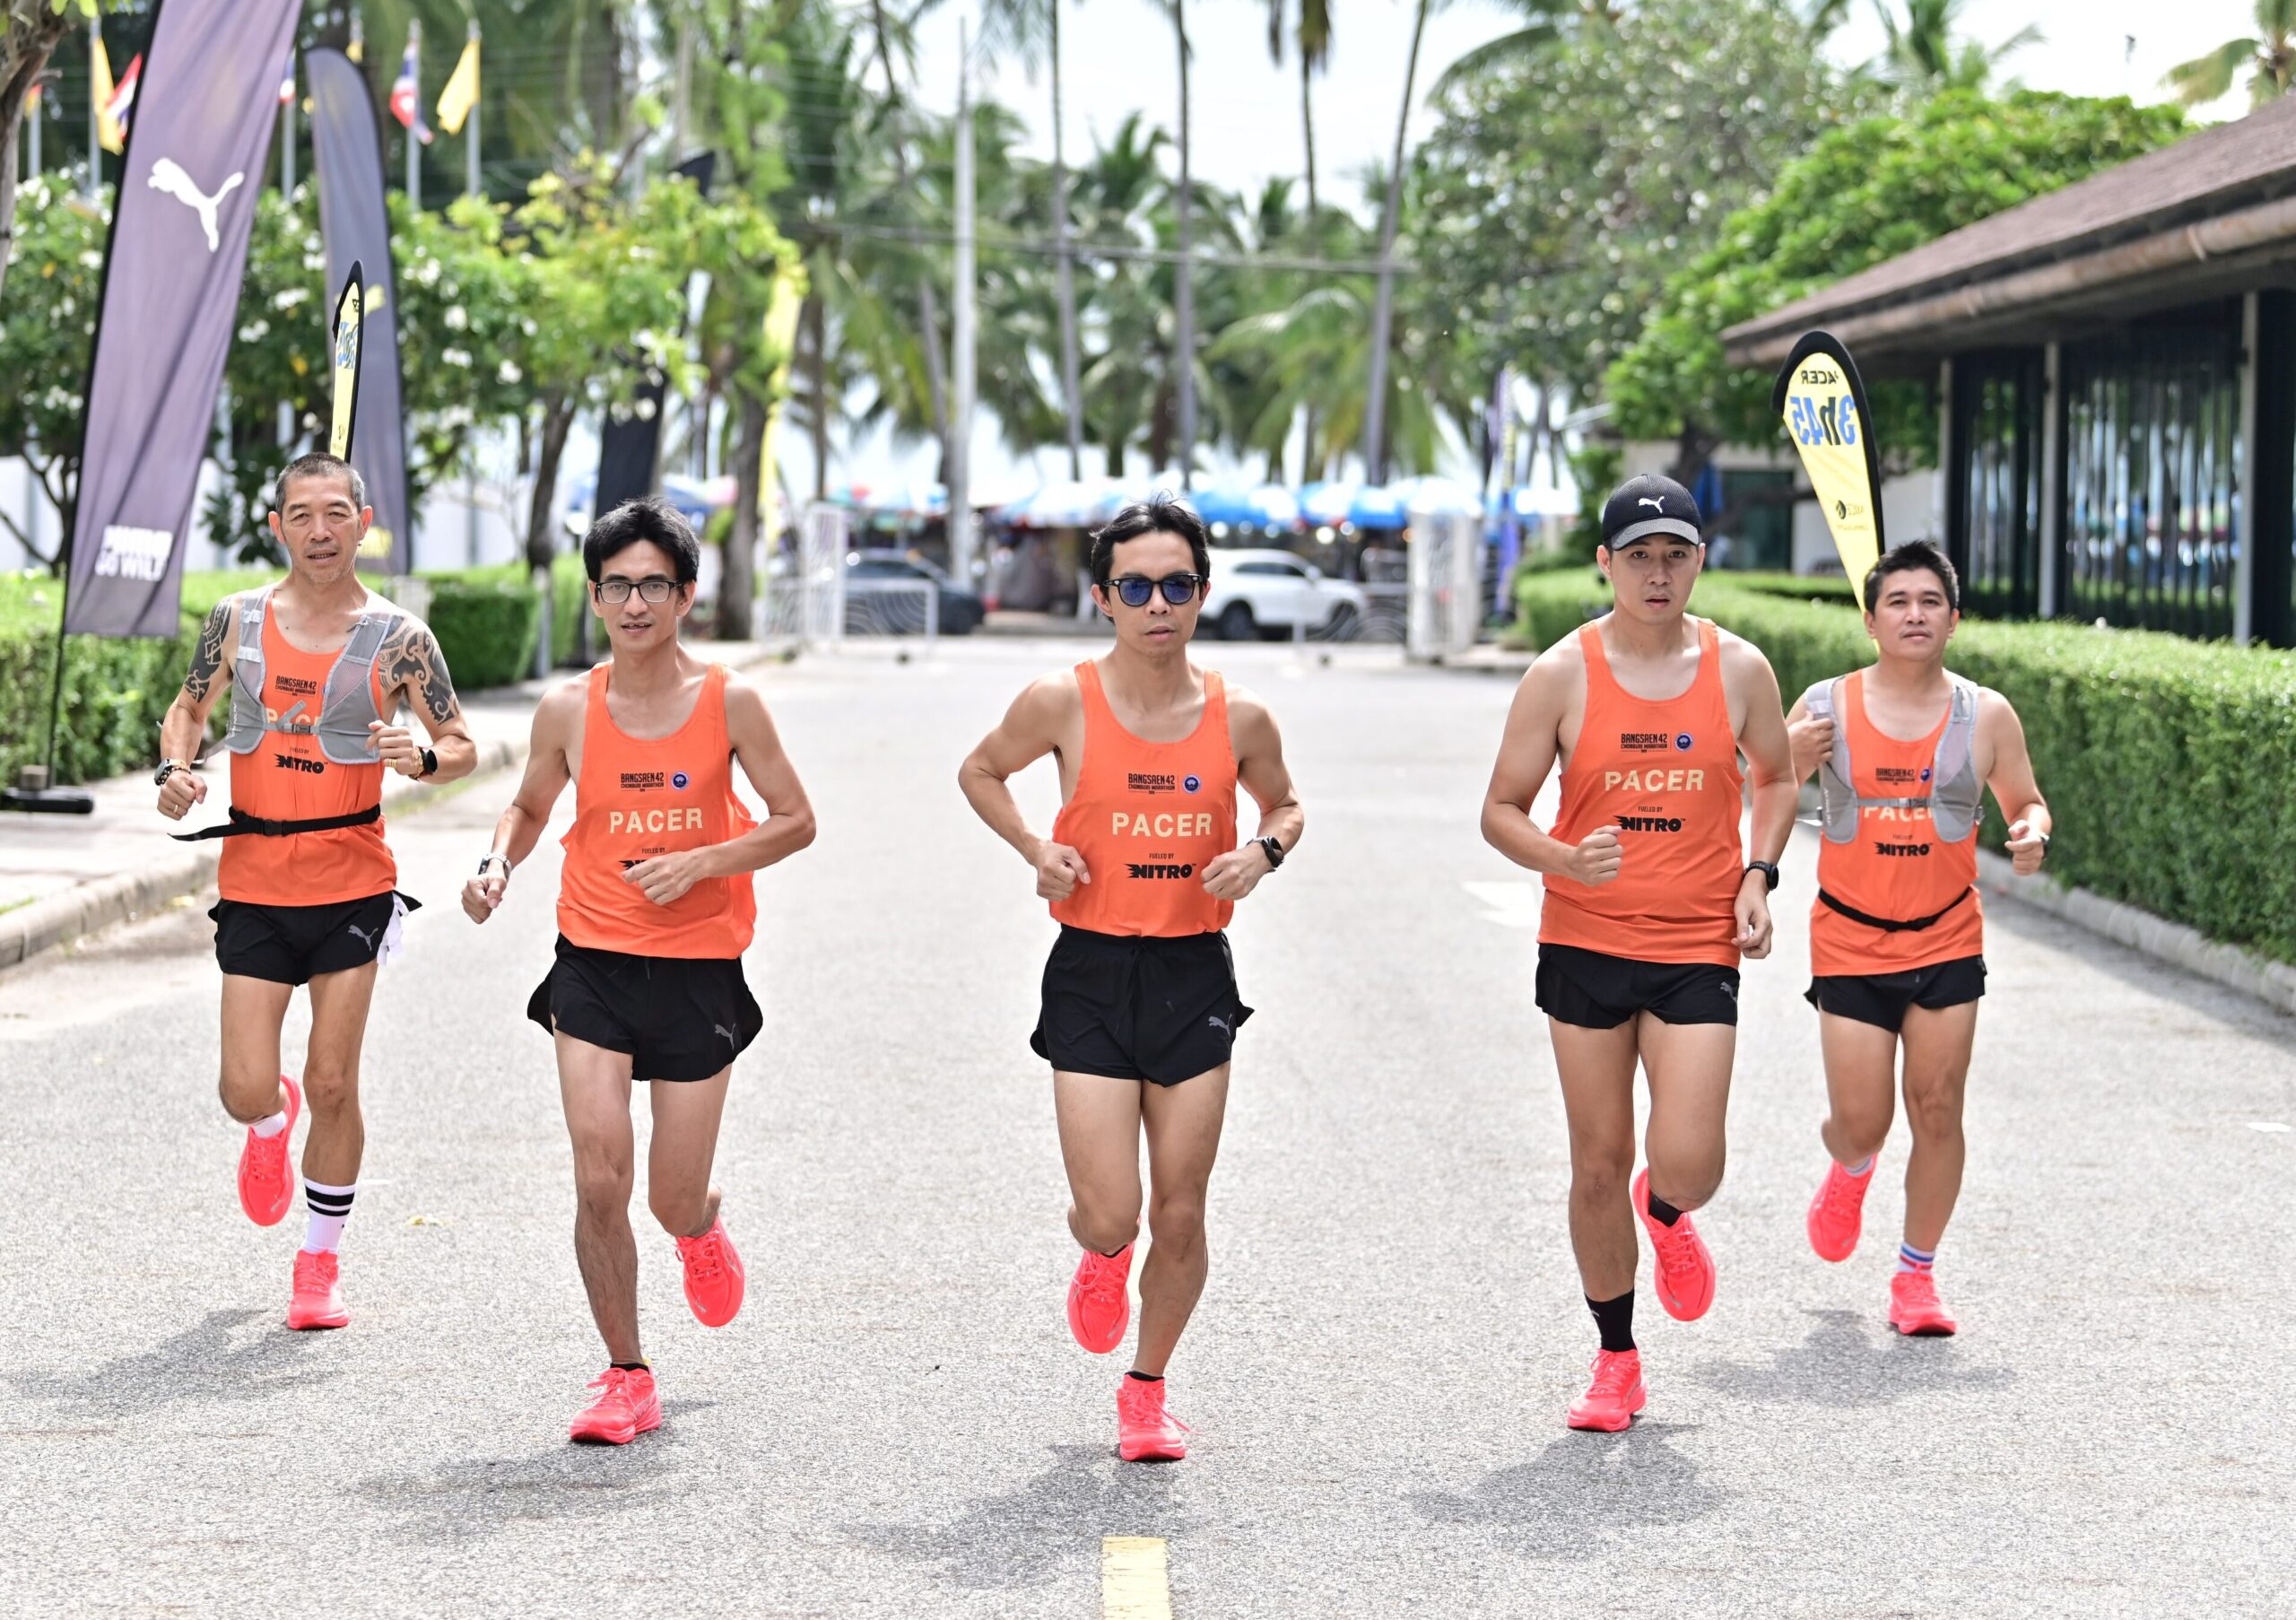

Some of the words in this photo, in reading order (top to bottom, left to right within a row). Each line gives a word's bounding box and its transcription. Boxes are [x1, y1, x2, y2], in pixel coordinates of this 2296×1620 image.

[308, 681, 317, 690] 42
[1621, 733, 1658, 744] BANGSAEN
[1658, 733, 1667, 744] 42
[621, 772, 655, 783] BANGSAEN
[656, 771, 664, 782] 42
[1127, 773, 1165, 785] BANGSAEN
[1166, 775, 1175, 785] 42
[1605, 769, 1704, 791] PACER
[610, 807, 703, 833] PACER
[1864, 806, 1932, 822] PACE
[1112, 812, 1212, 838] PACER
